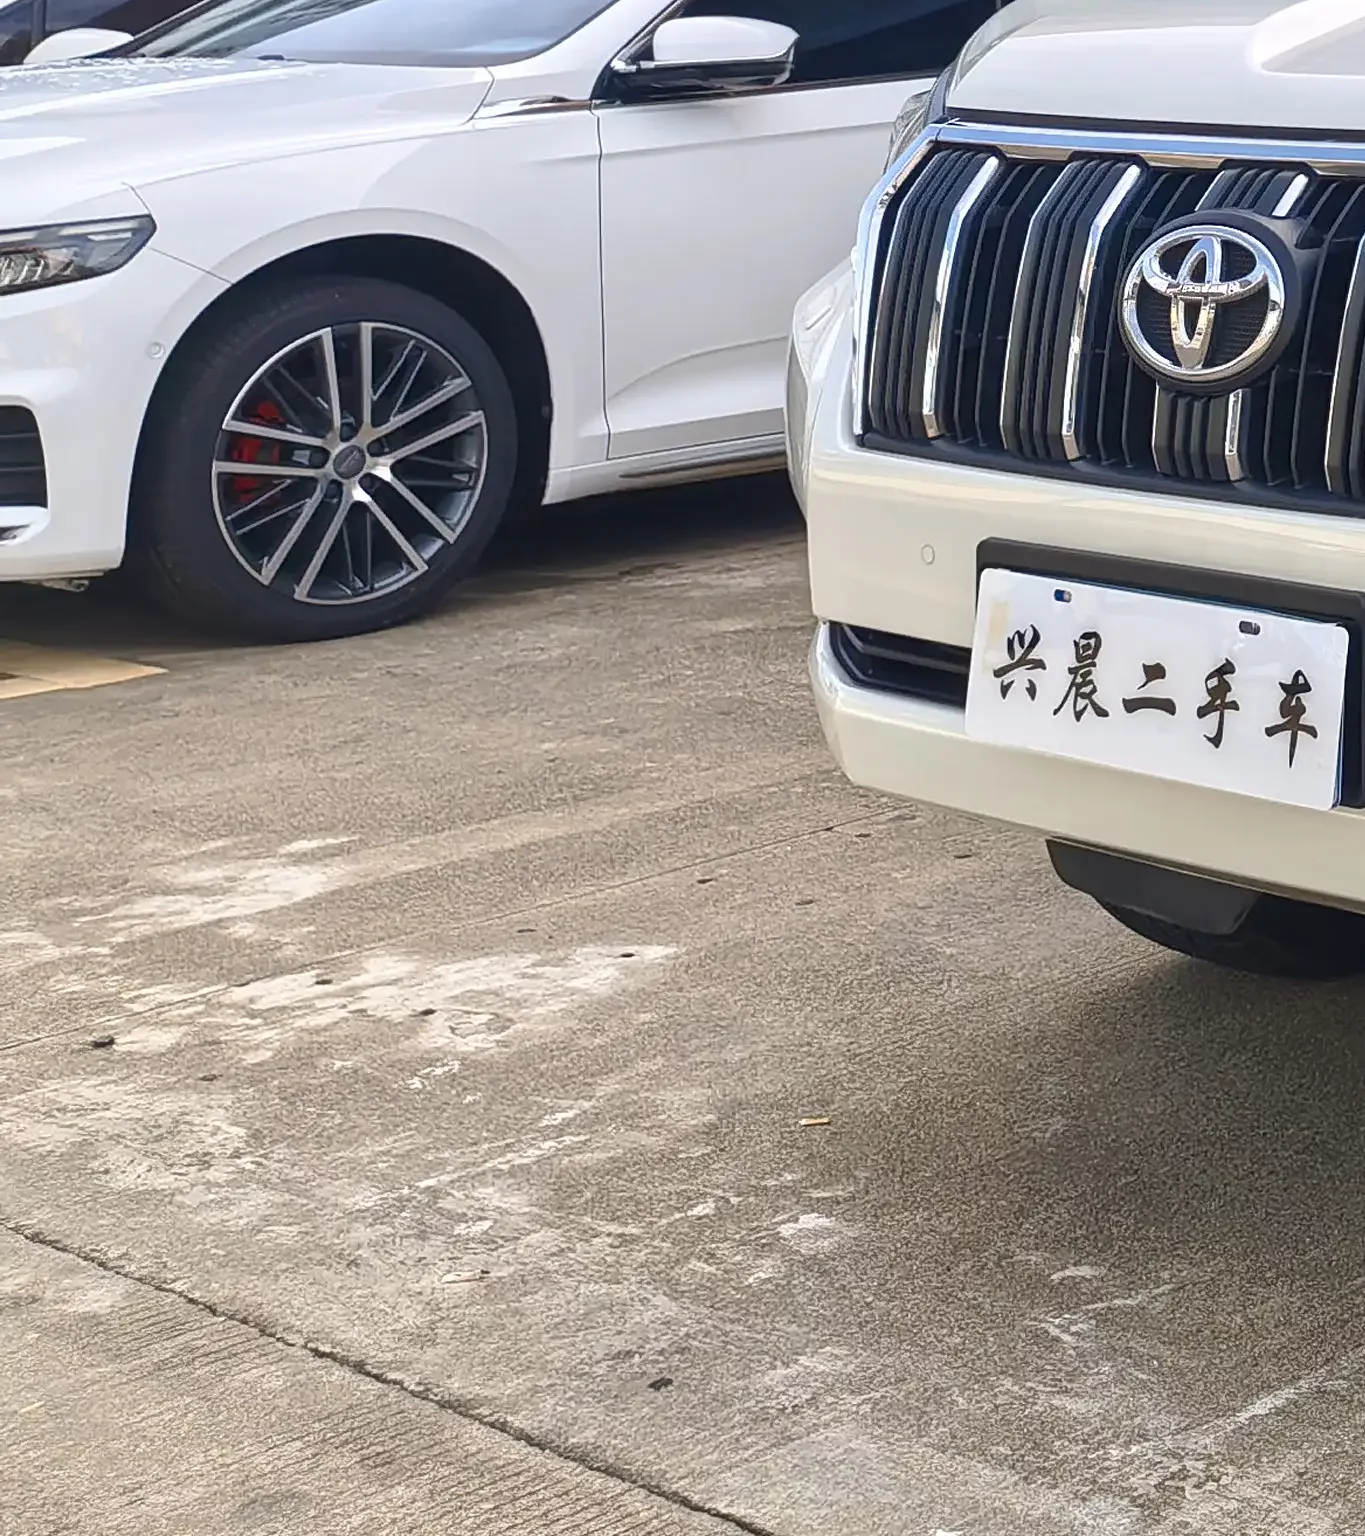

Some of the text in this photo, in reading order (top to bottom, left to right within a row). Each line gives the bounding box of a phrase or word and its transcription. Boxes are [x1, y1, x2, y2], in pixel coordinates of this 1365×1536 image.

[992, 623, 1319, 768] 兴晨二手车
